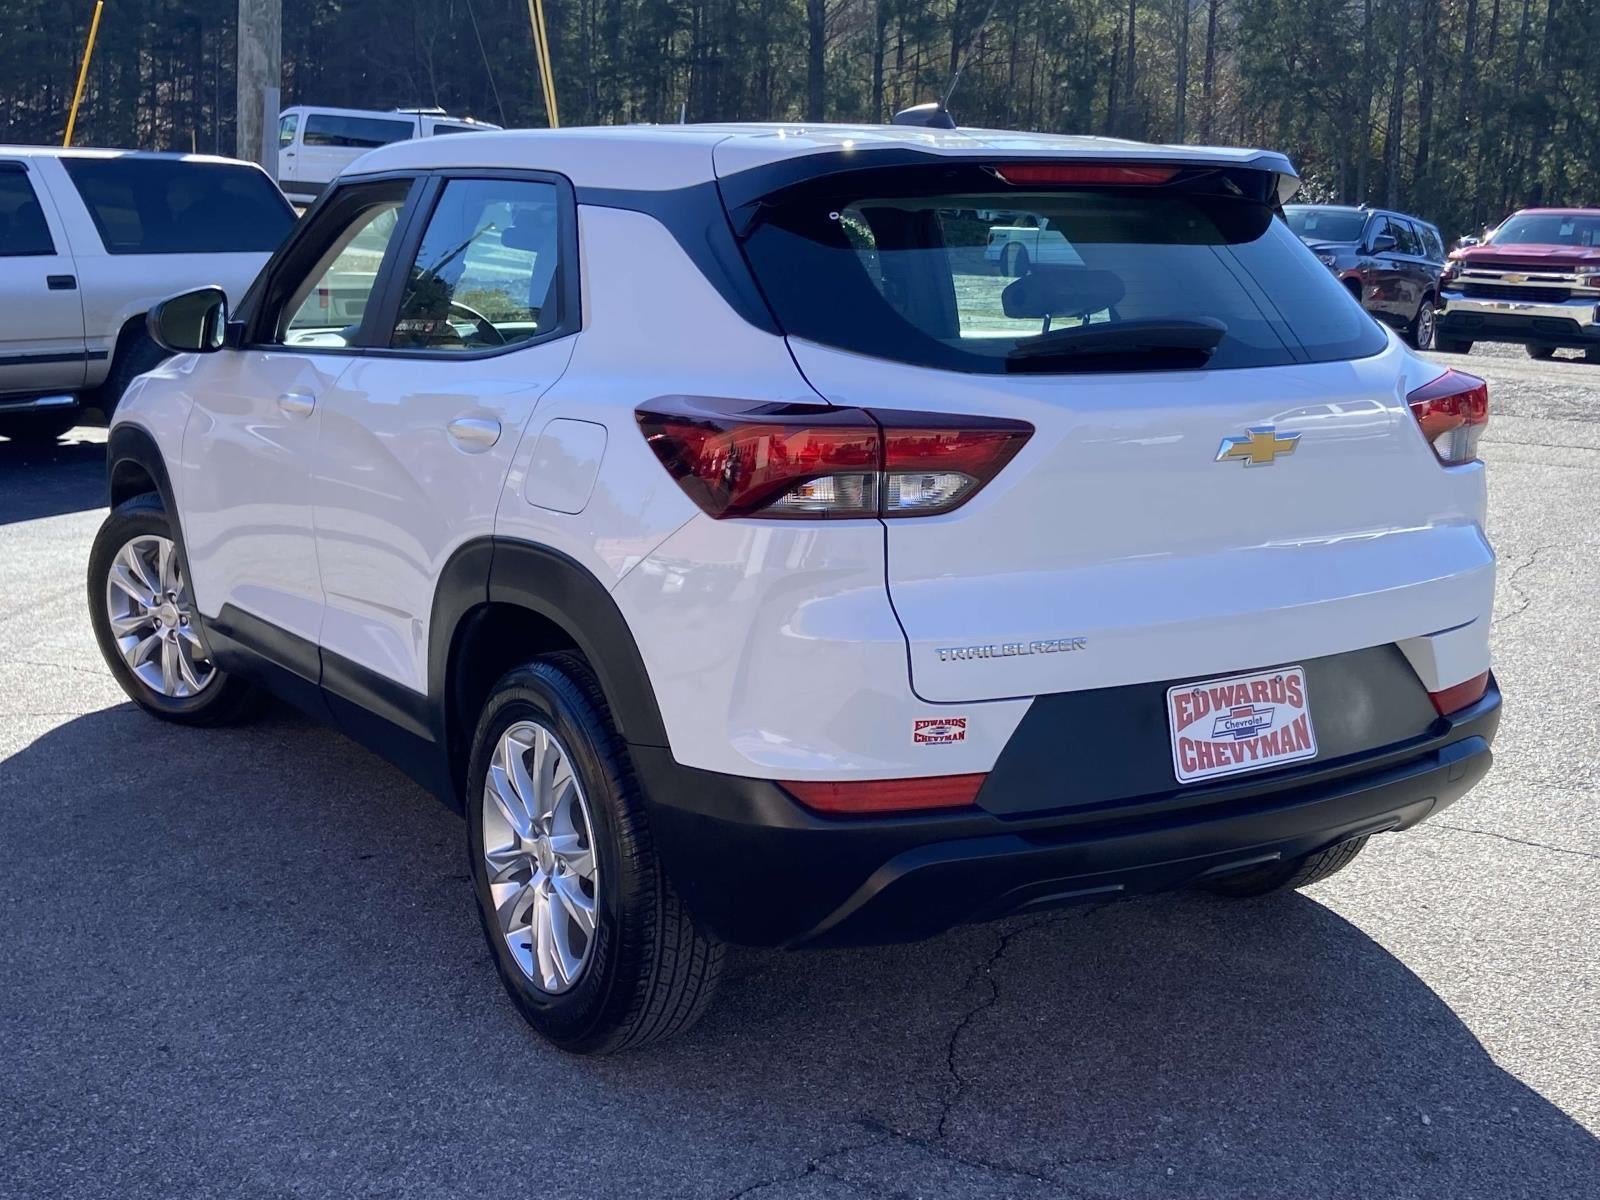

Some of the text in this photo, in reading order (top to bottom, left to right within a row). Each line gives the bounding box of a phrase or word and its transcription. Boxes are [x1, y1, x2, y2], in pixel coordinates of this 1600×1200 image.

[935, 637, 1087, 661] TRAILBLAZER
[1174, 674, 1304, 733] EDWARDS
[914, 718, 966, 731] EDWARDS
[1224, 716, 1263, 730] Chevrolet
[914, 730, 965, 743] CHEVYMAN
[1179, 713, 1312, 773] CHEVYMAN
